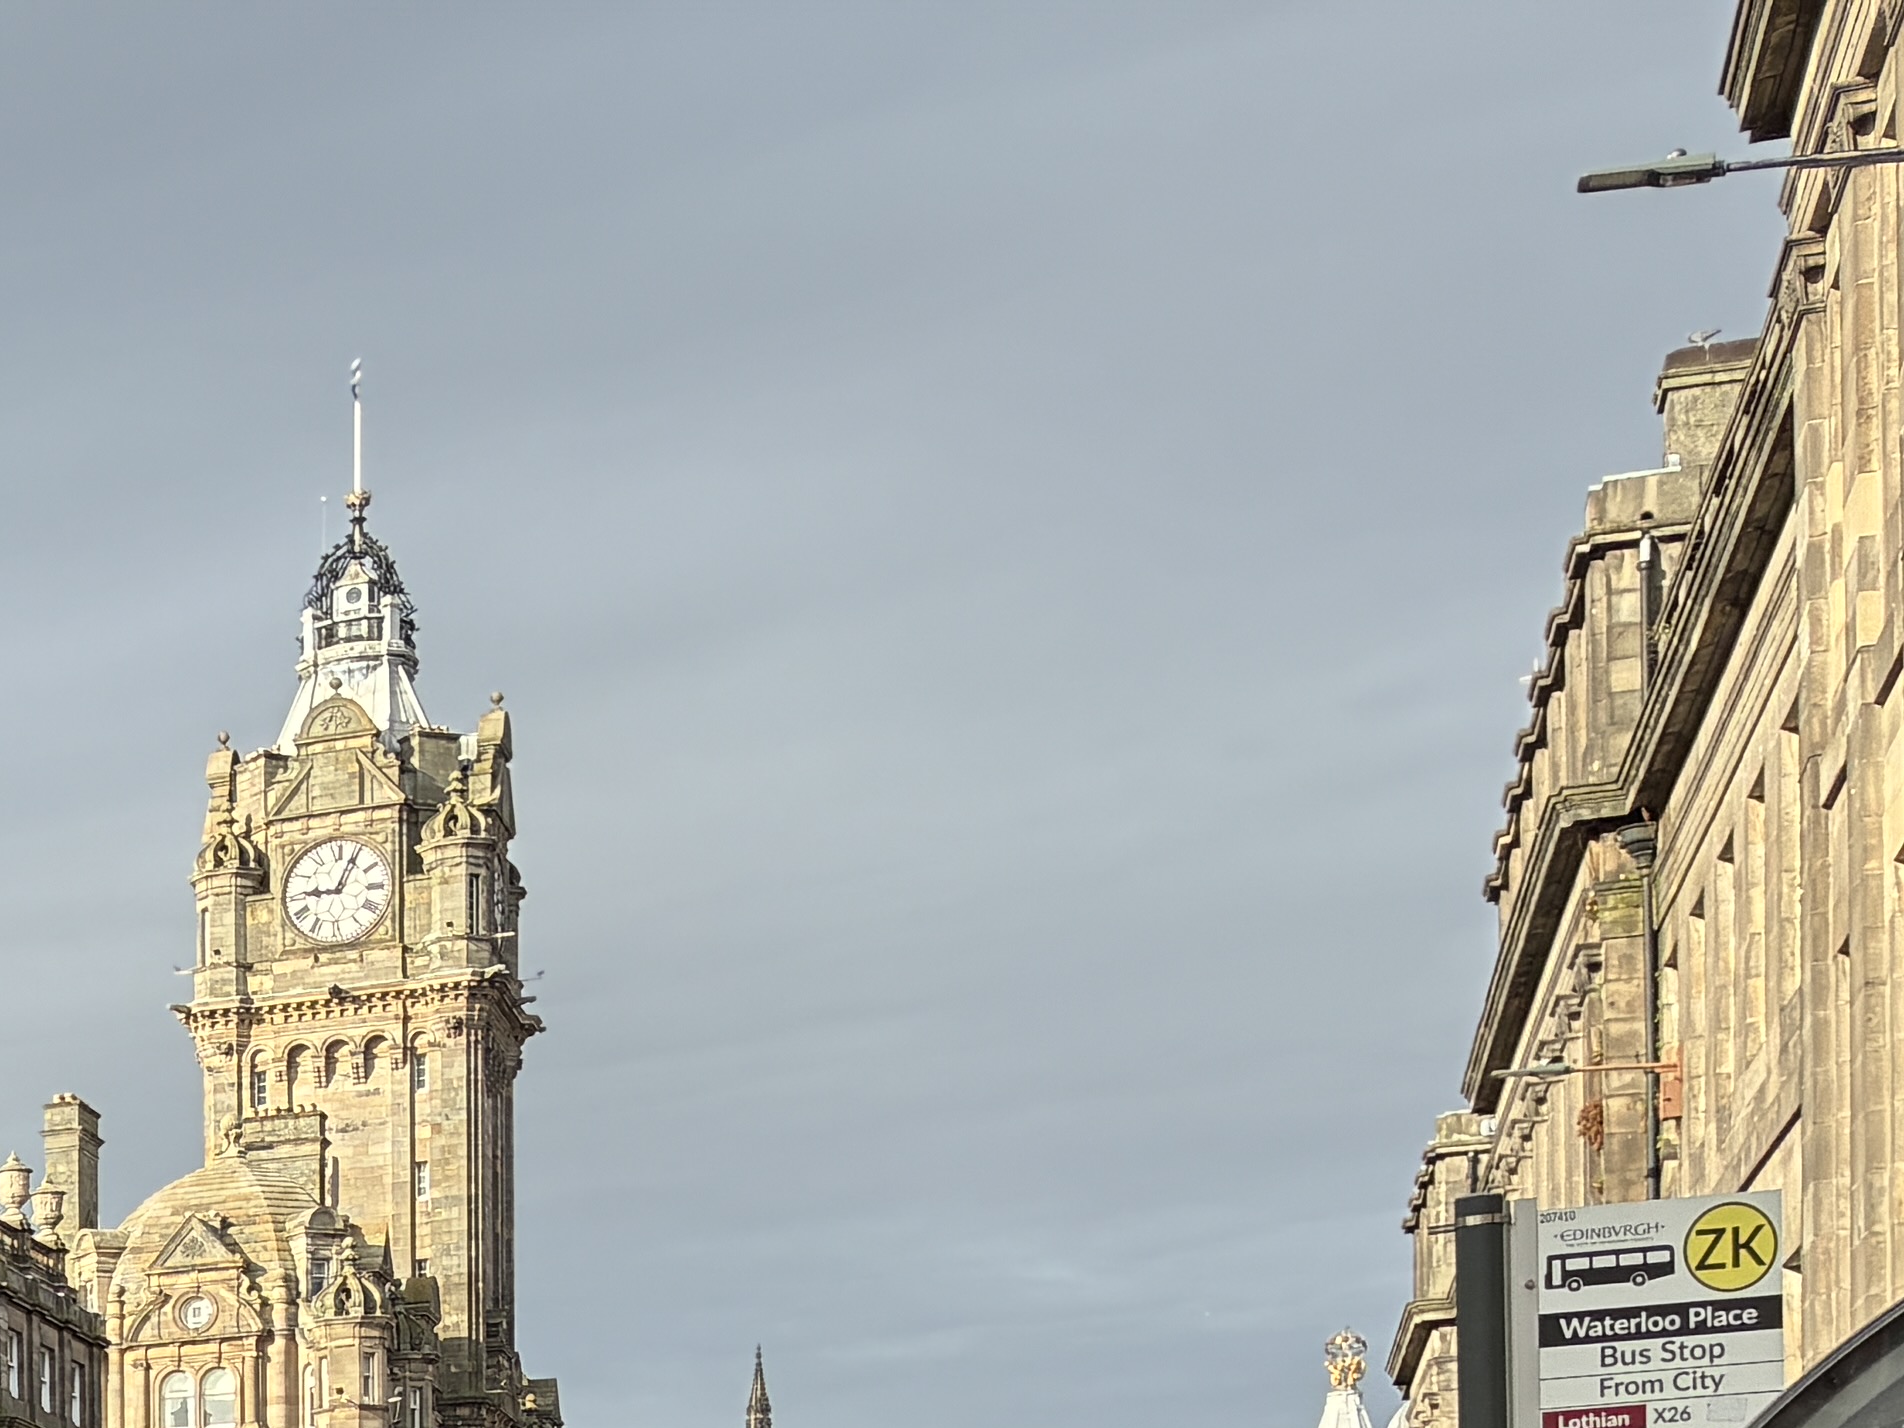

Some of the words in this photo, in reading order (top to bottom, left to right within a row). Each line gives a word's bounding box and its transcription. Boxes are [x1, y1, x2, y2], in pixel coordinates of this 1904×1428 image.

[1695, 1224, 1767, 1271] ZK
[1559, 1311, 1681, 1339] Waterloo
[1688, 1306, 1759, 1330] Place
[1600, 1345, 1651, 1368] Bus
[1661, 1340, 1725, 1364] Stop
[1600, 1376, 1663, 1398] From
[1673, 1370, 1725, 1392] City
[1653, 1406, 1692, 1424] X26
